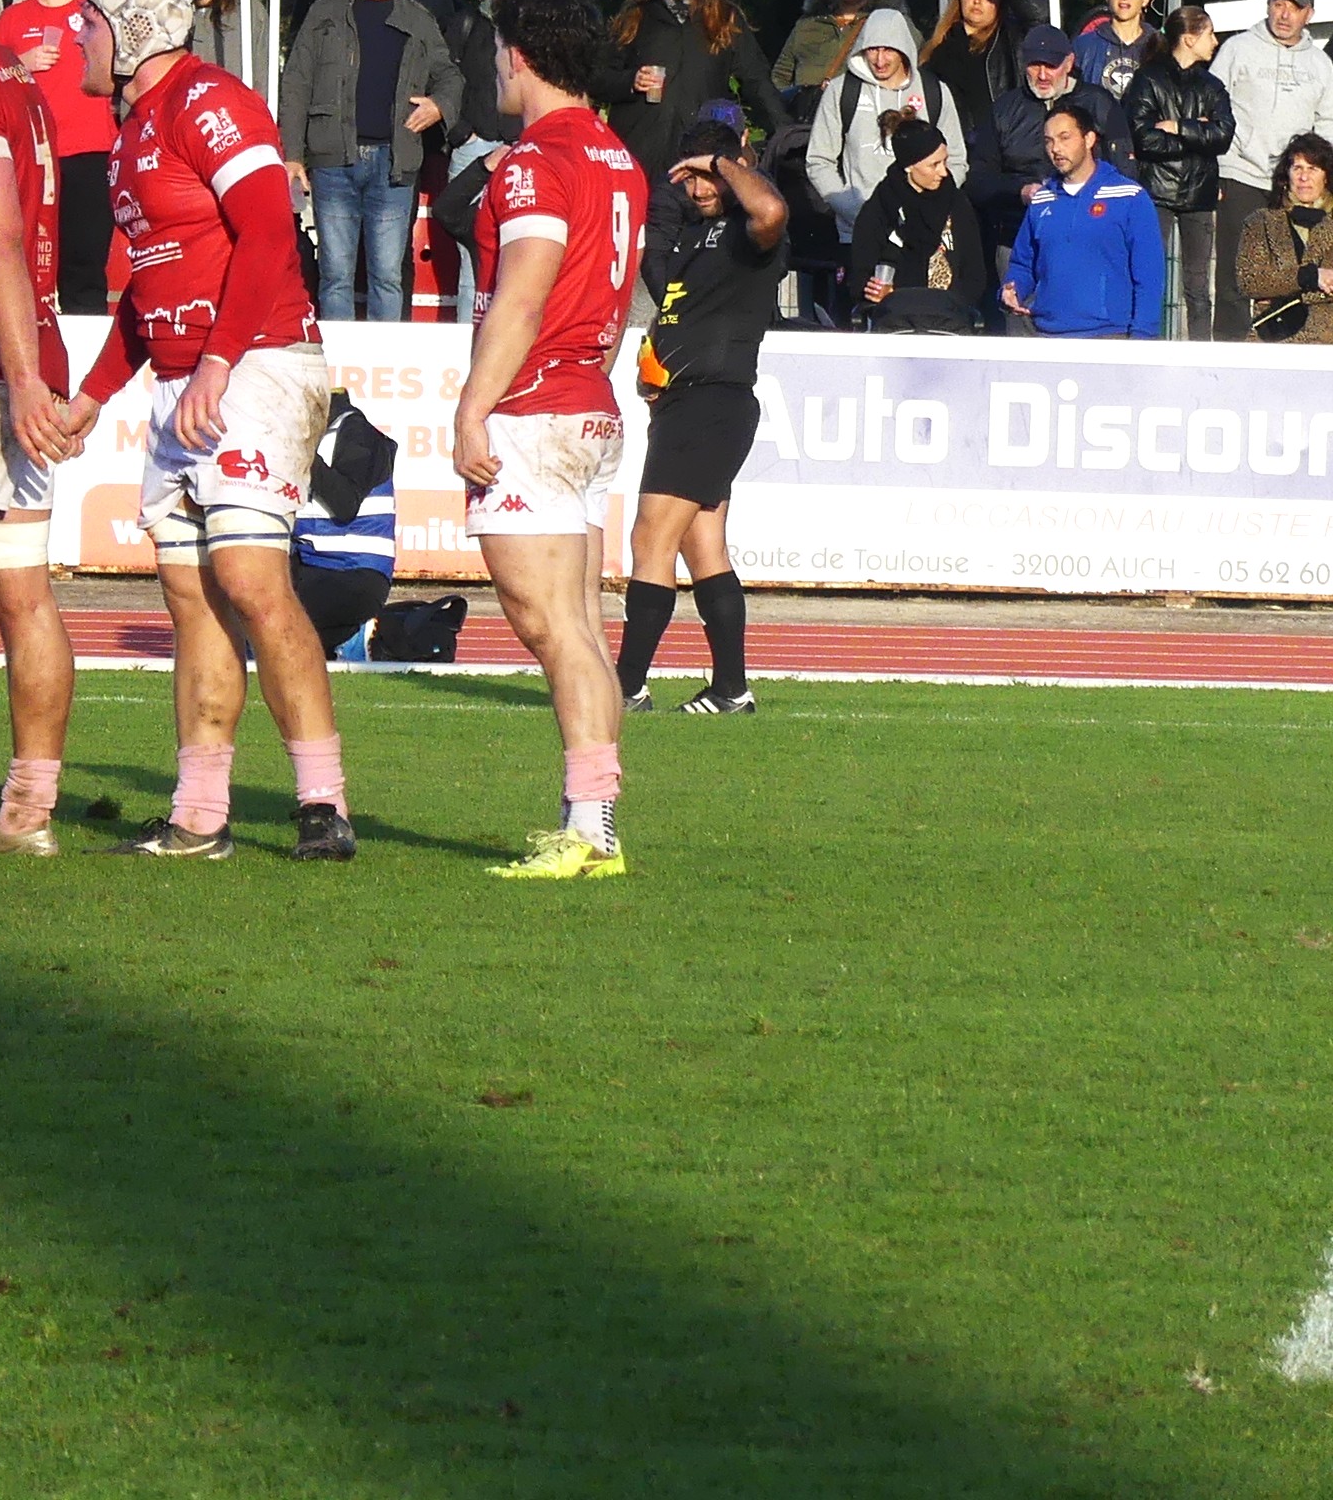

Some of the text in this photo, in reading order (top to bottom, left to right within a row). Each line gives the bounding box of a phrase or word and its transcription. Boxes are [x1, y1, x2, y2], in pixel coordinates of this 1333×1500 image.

[26, 105, 55, 205] 4
[610, 191, 630, 291] 9
[753, 373, 950, 464] Auto
[724, 544, 801, 568] Route
[811, 547, 844, 570] de
[854, 547, 969, 574] Toulouse
[1011, 553, 1091, 577] 32000
[1100, 556, 1175, 579] AUCH
[1218, 560, 1249, 582] 05
[1259, 561, 1289, 584] 62
[1299, 562, 1331, 585] 60
